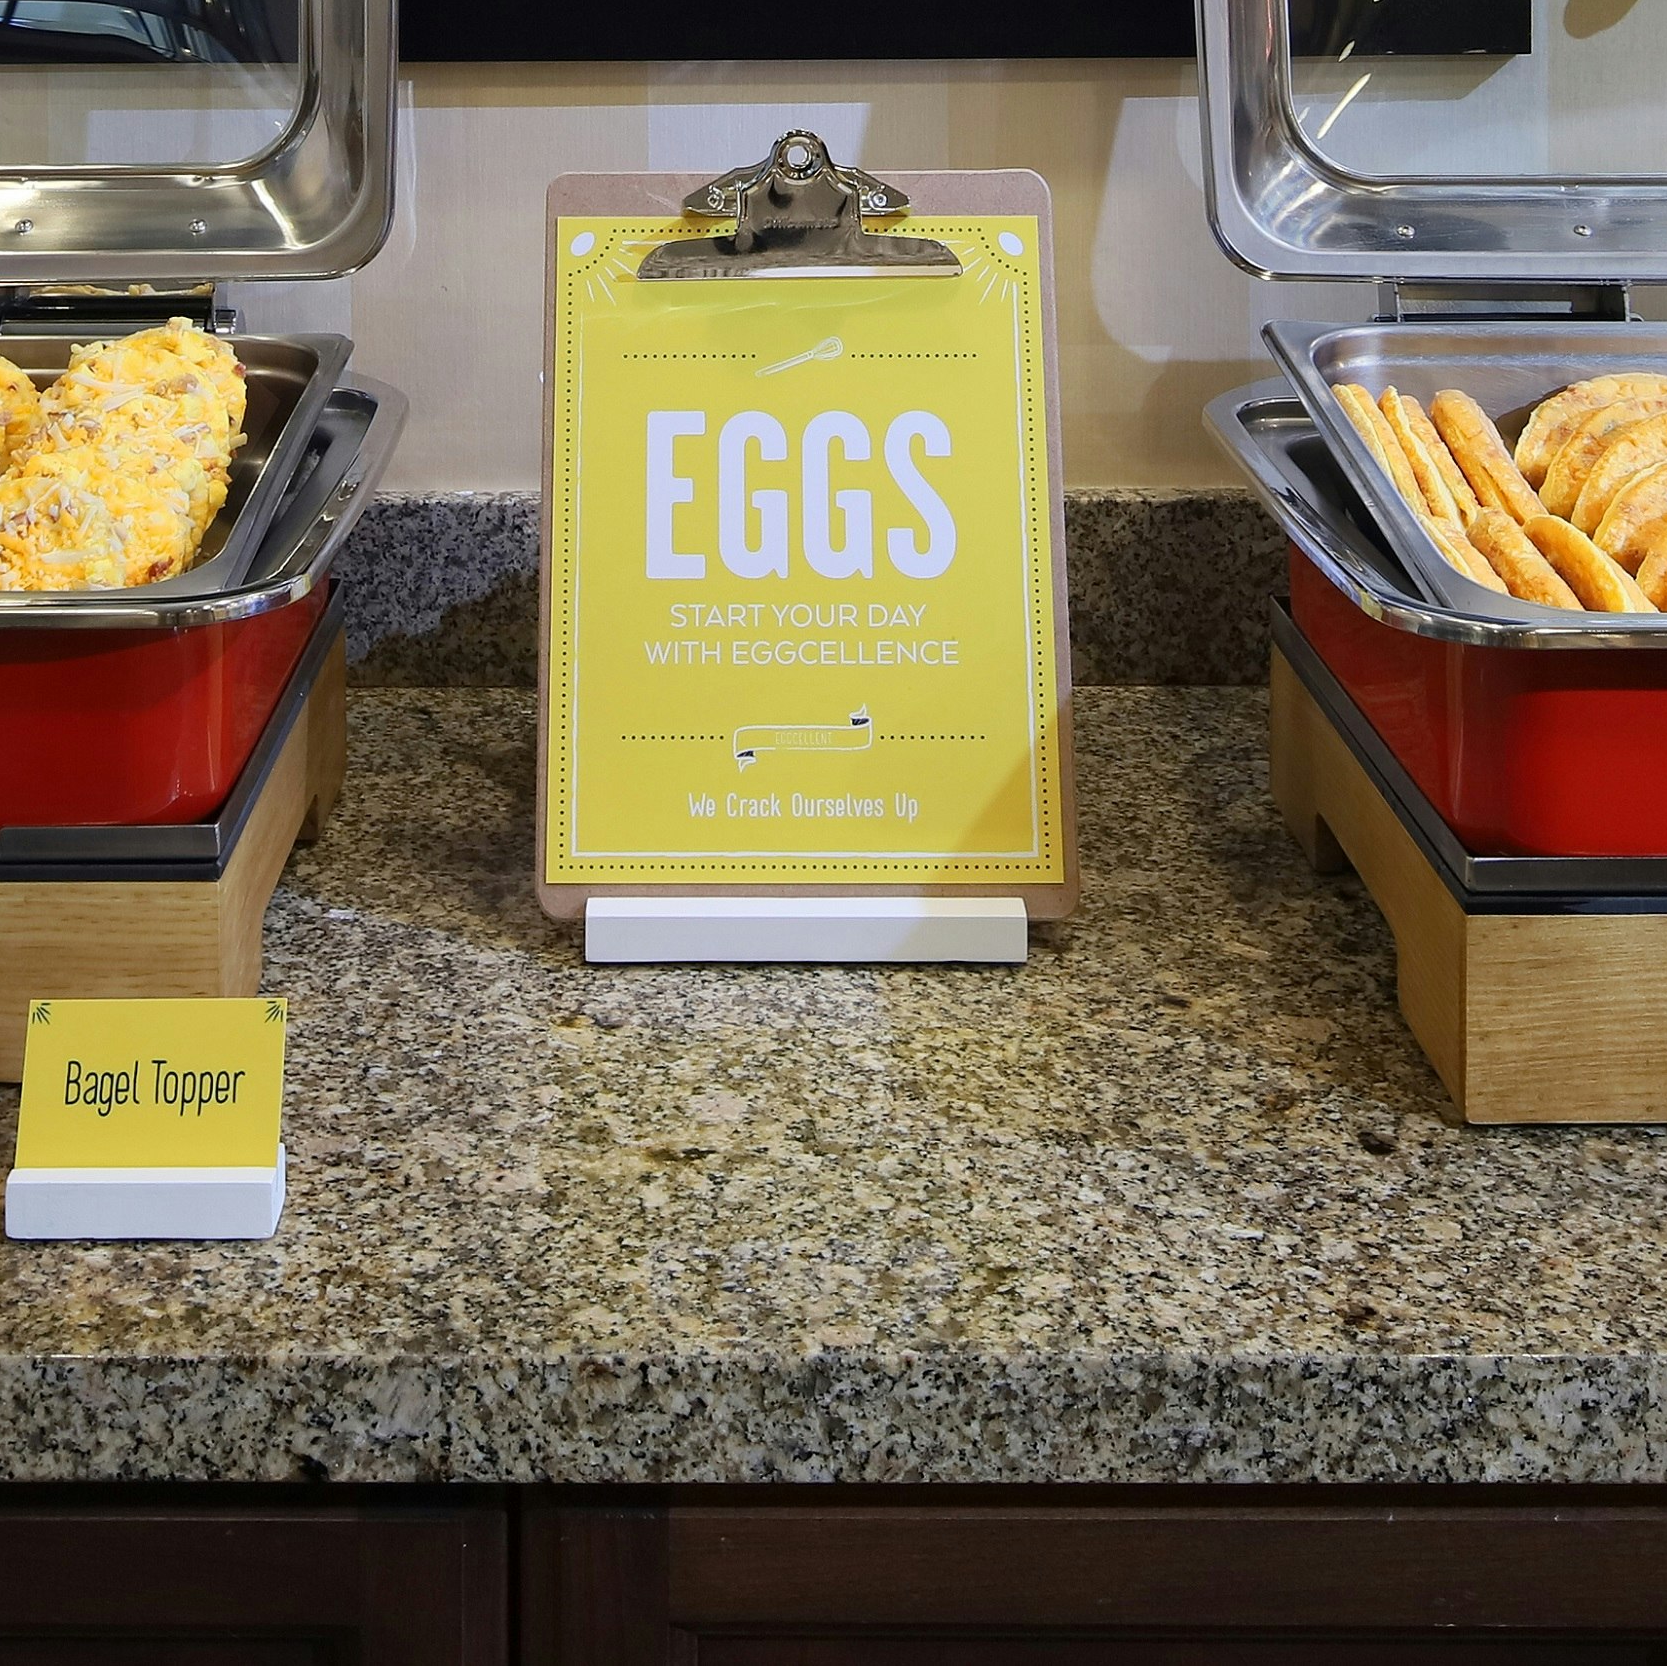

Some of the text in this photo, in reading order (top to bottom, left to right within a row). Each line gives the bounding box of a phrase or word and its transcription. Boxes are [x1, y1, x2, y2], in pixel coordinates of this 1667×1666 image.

[645, 410, 958, 579] EGGS
[670, 603, 927, 628] START YOUR DAY
[643, 640, 960, 665] WITH EGGCELLENCE
[688, 792, 919, 824] We Crack Ourselves Up
[64, 1060, 246, 1117] Bagel Topper
